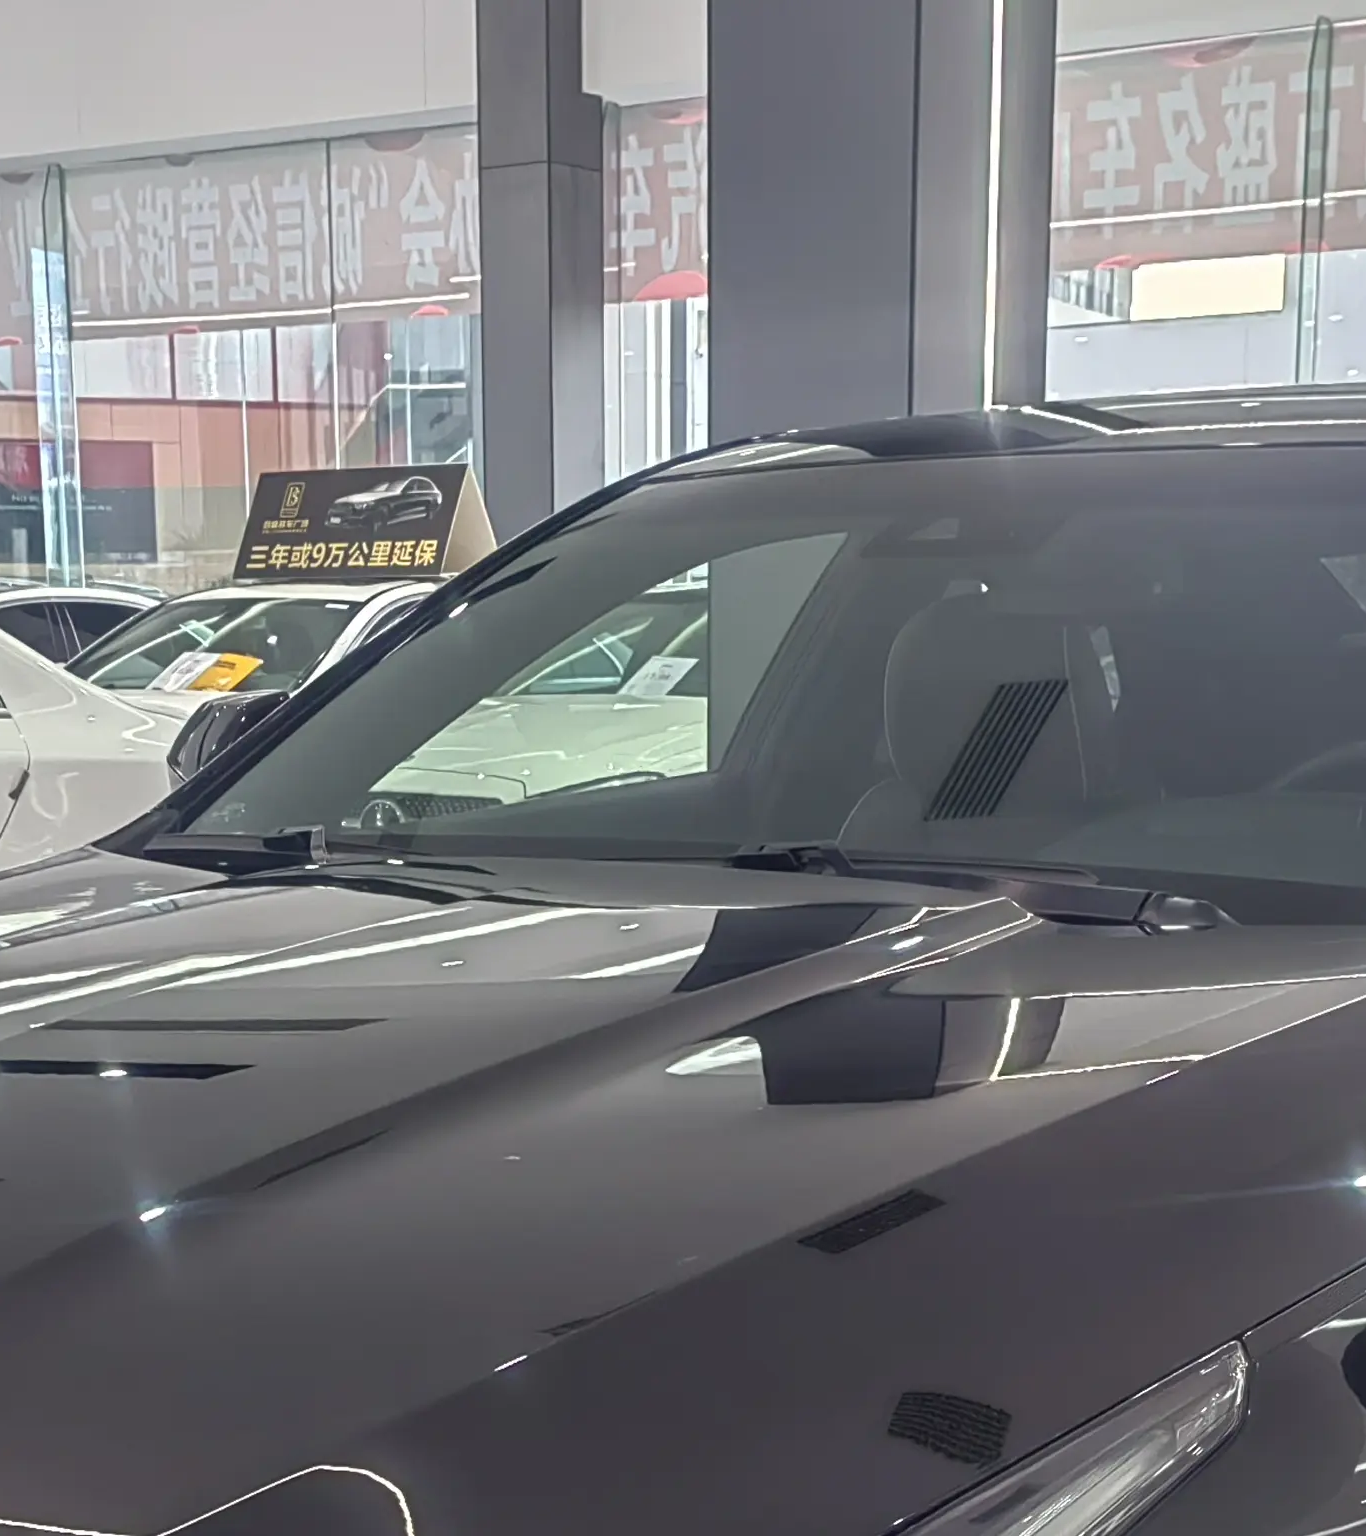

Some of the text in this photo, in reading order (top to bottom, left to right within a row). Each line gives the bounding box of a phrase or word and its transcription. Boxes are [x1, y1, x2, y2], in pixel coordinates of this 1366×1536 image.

[246, 539, 438, 570] 三年或9万公里延保
